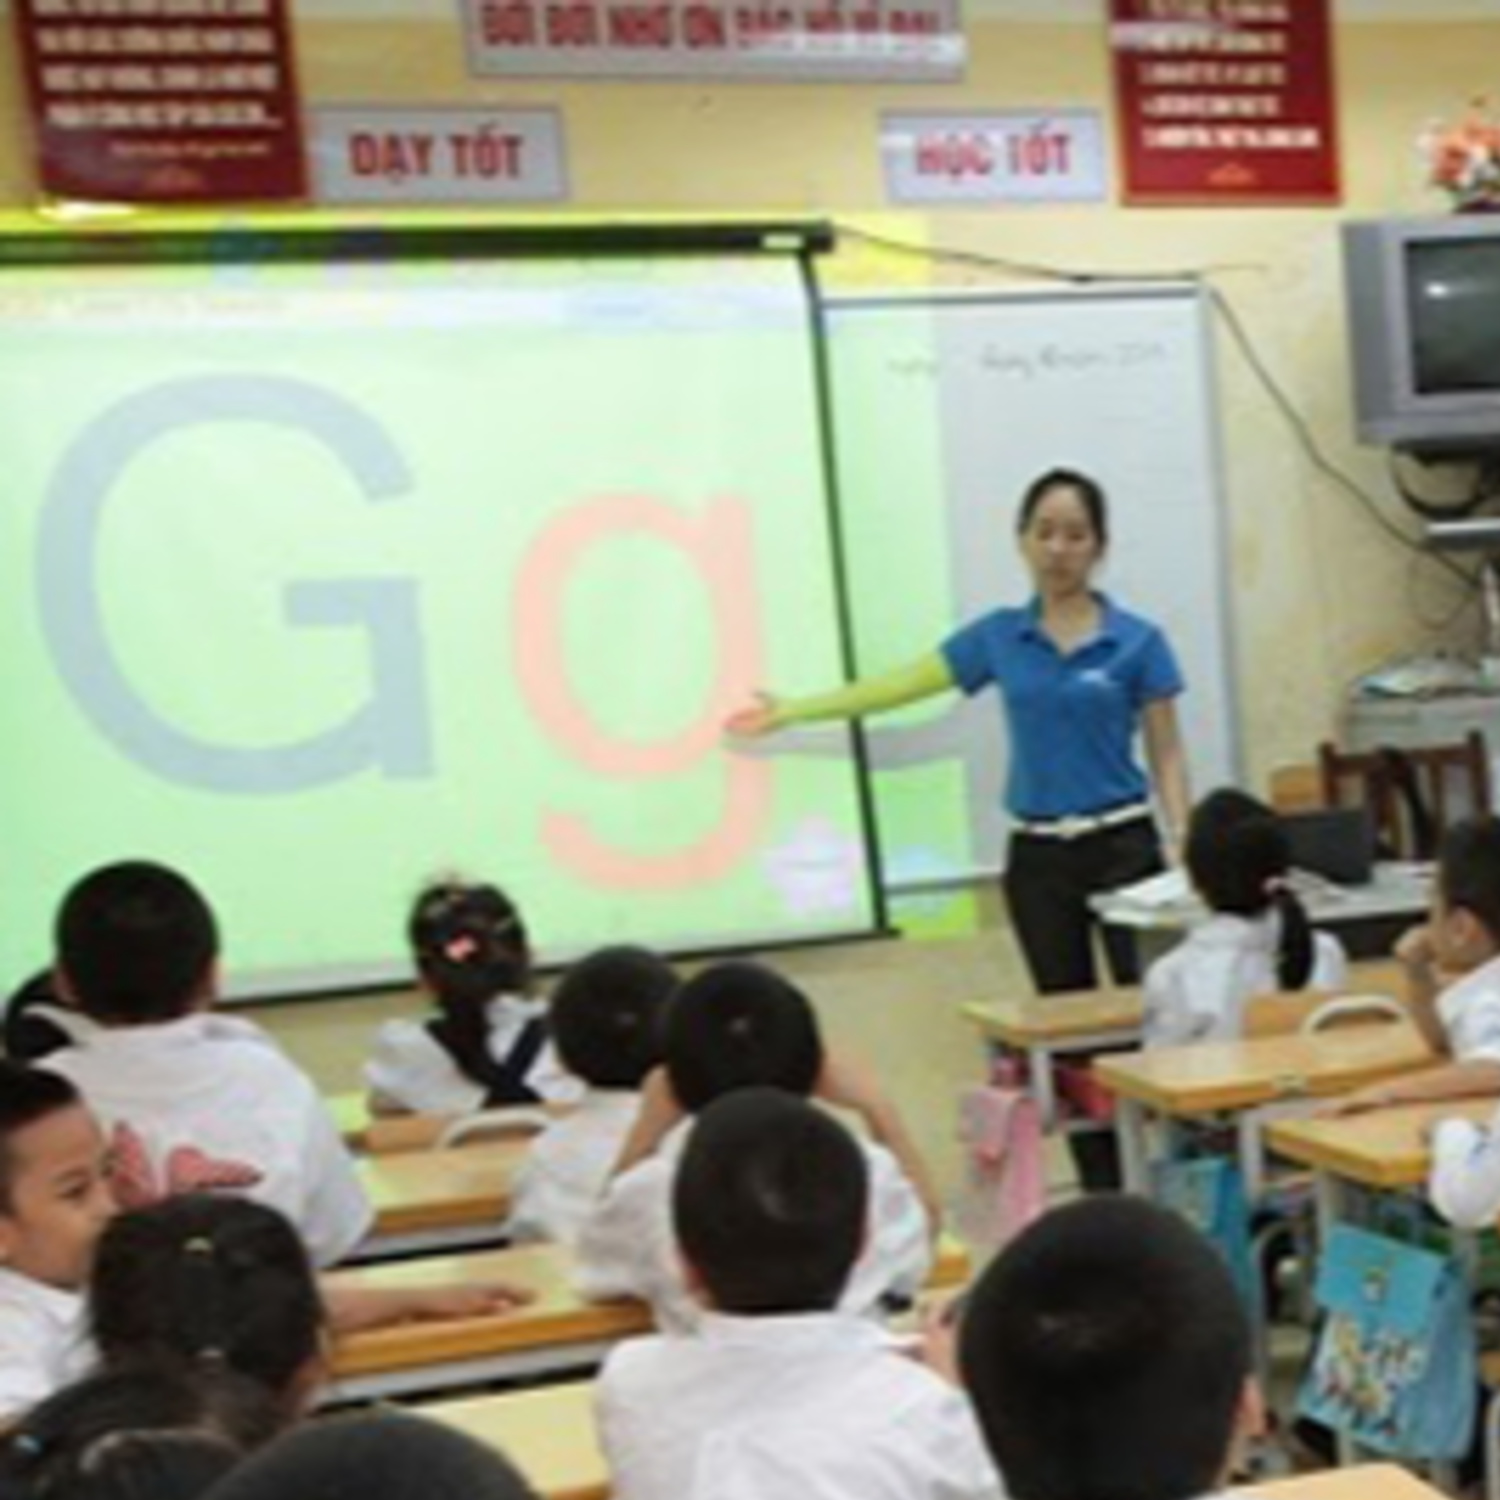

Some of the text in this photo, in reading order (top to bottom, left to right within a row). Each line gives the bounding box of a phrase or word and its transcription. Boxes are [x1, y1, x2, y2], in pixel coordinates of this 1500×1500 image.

[350, 119, 523, 185] DẠY TỐT
[917, 119, 1071, 184] HỌC TỐT
